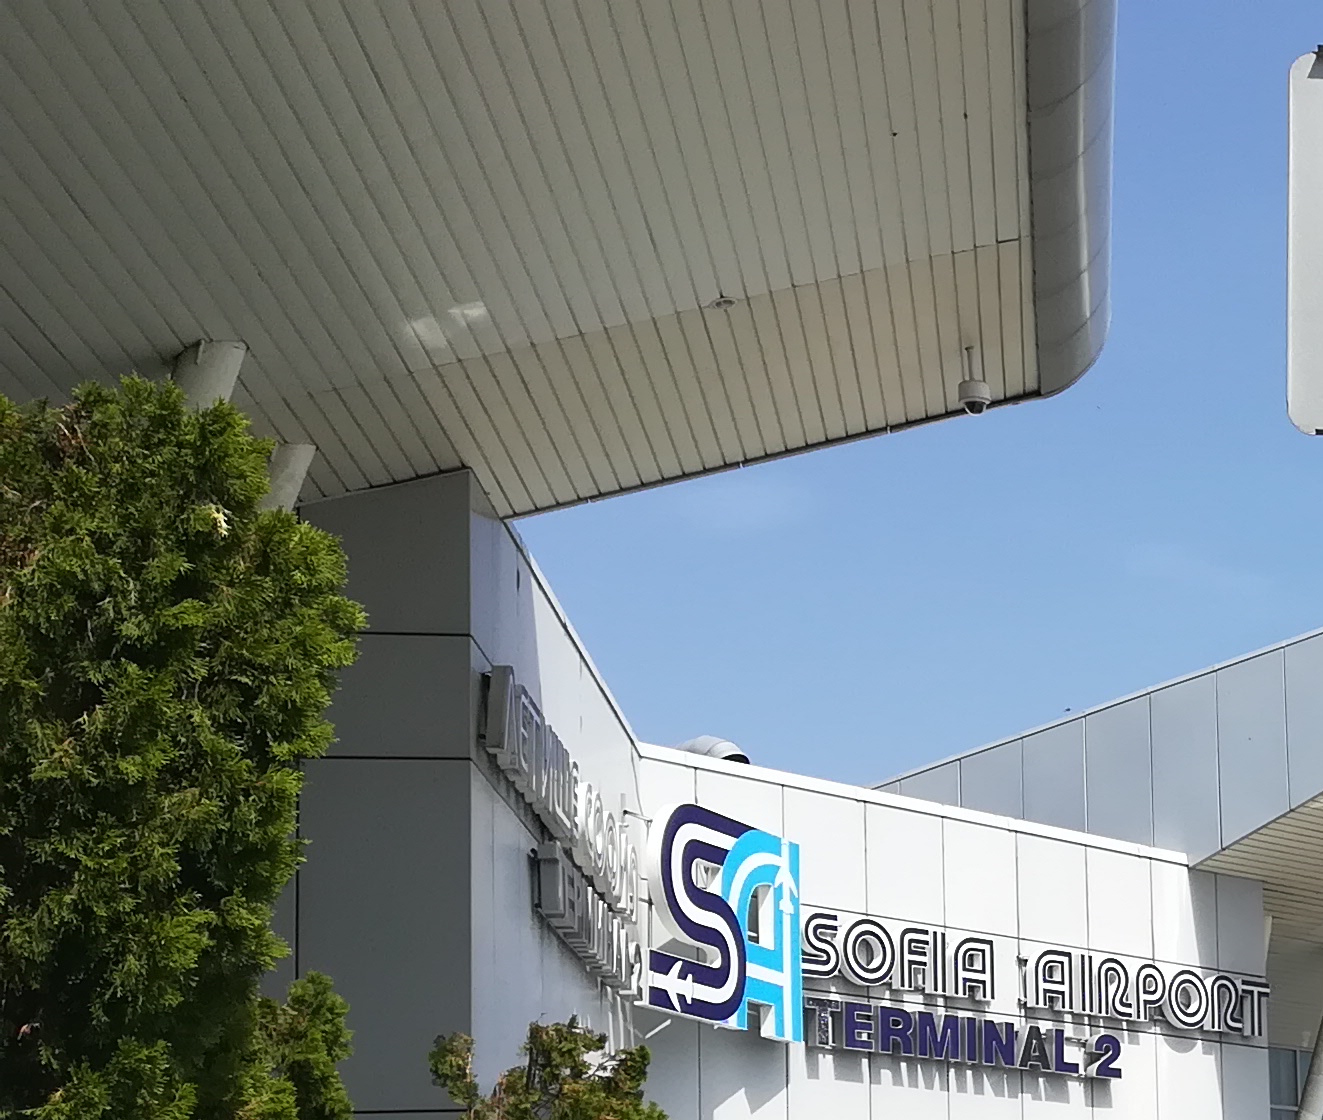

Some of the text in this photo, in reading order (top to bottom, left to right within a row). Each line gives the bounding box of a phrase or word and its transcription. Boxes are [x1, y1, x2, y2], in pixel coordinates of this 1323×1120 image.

[802, 912, 1270, 1037] SOFIA AIRPORT
[803, 997, 1123, 1079] TERMINAL 2
